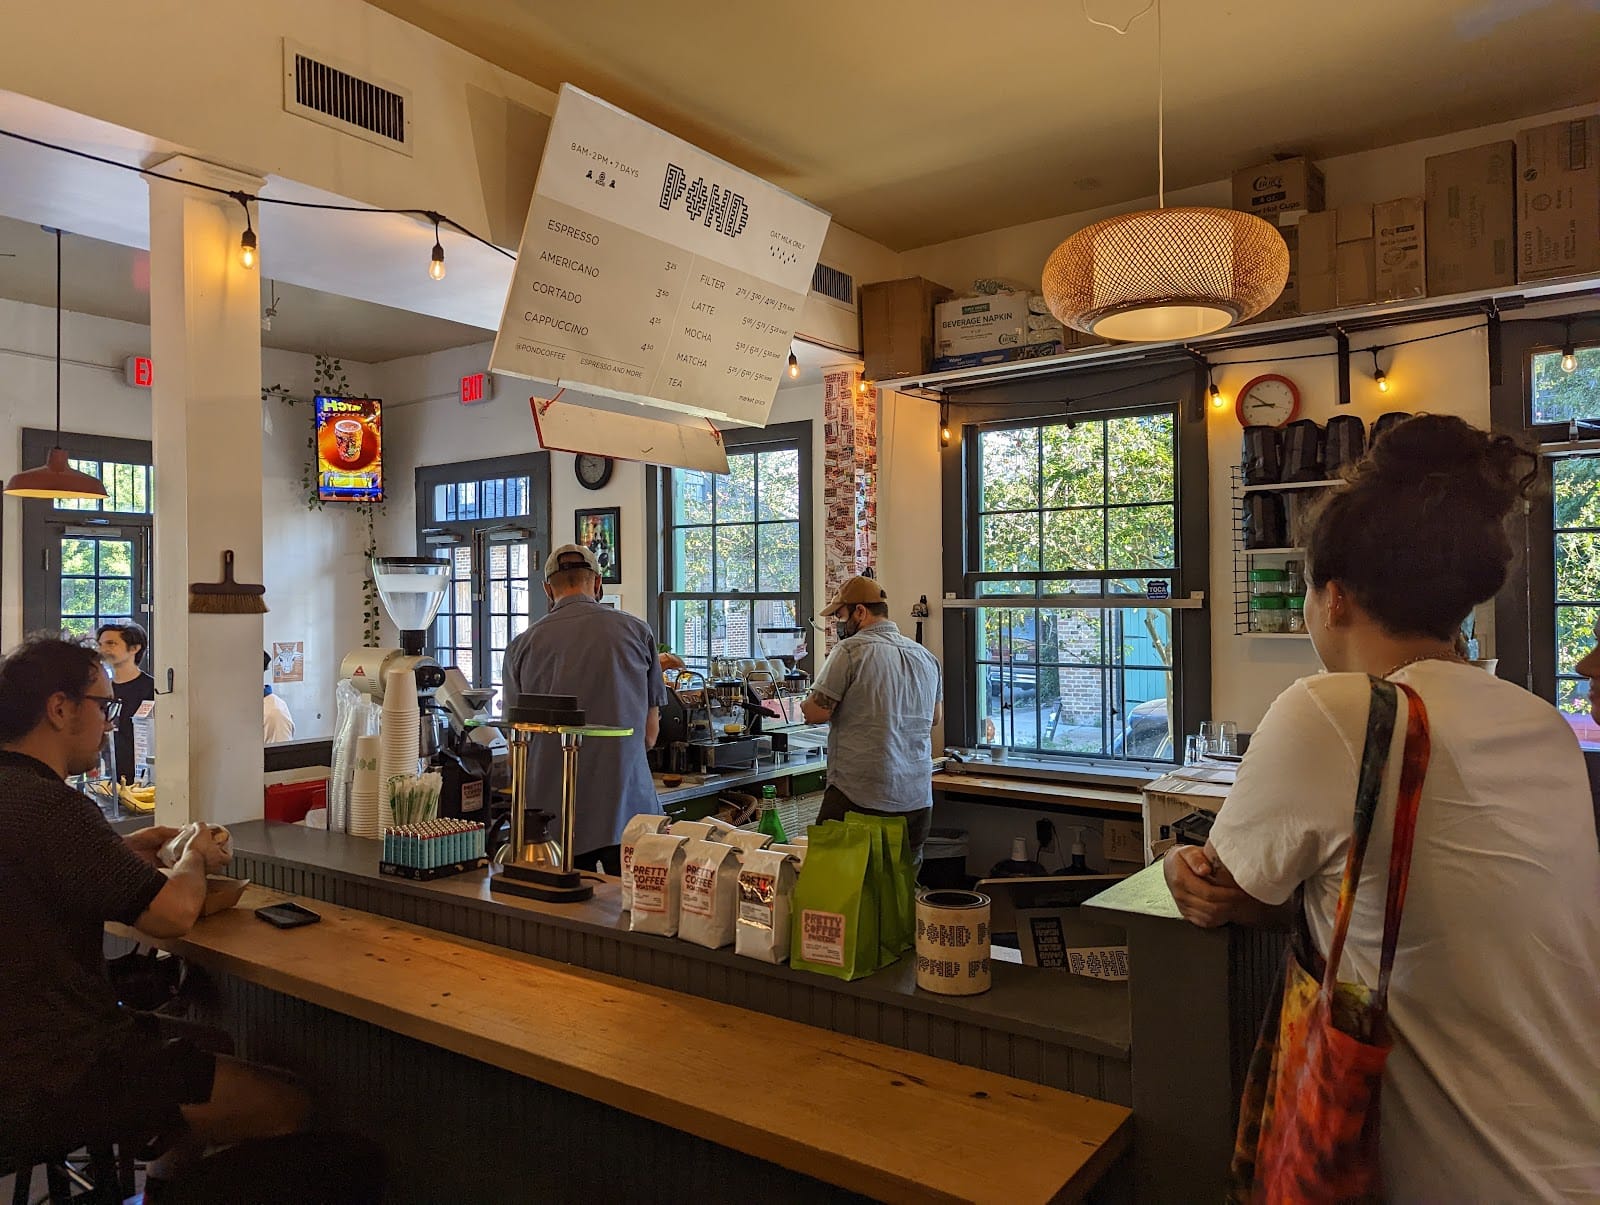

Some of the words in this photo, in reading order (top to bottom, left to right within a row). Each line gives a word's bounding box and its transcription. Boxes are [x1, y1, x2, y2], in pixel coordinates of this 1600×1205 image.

[620, 164, 639, 178] DAYS
[659, 163, 749, 238] POND
[547, 219, 600, 246] ESPRESSO
[770, 230, 781, 239] OAT
[539, 251, 600, 278] AMERICANO
[700, 274, 726, 291] FILTER
[532, 281, 582, 304] CORTADO
[691, 300, 716, 315] LATTE
[524, 311, 589, 336] CAPPUCCINO
[942, 316, 981, 329] BEVERAGE
[982, 312, 1013, 324] NAPKIN
[684, 327, 712, 343] MOCHA
[516, 343, 567, 361] @PONDCOFFEE
[580, 357, 612, 372] ESPRESSO
[612, 364, 626, 374] AND
[626, 368, 643, 379] MORE
[676, 353, 707, 368] MATCHA
[462, 374, 484, 402] EXIT
[667, 377, 683, 388] TEA
[633, 865, 668, 877] PRETTY
[686, 864, 715, 879] PRETTY
[634, 874, 666, 886] COFFEE
[685, 874, 713, 889] COFFEE
[804, 912, 842, 927] PRETTY
[804, 923, 841, 938] COFFEE
